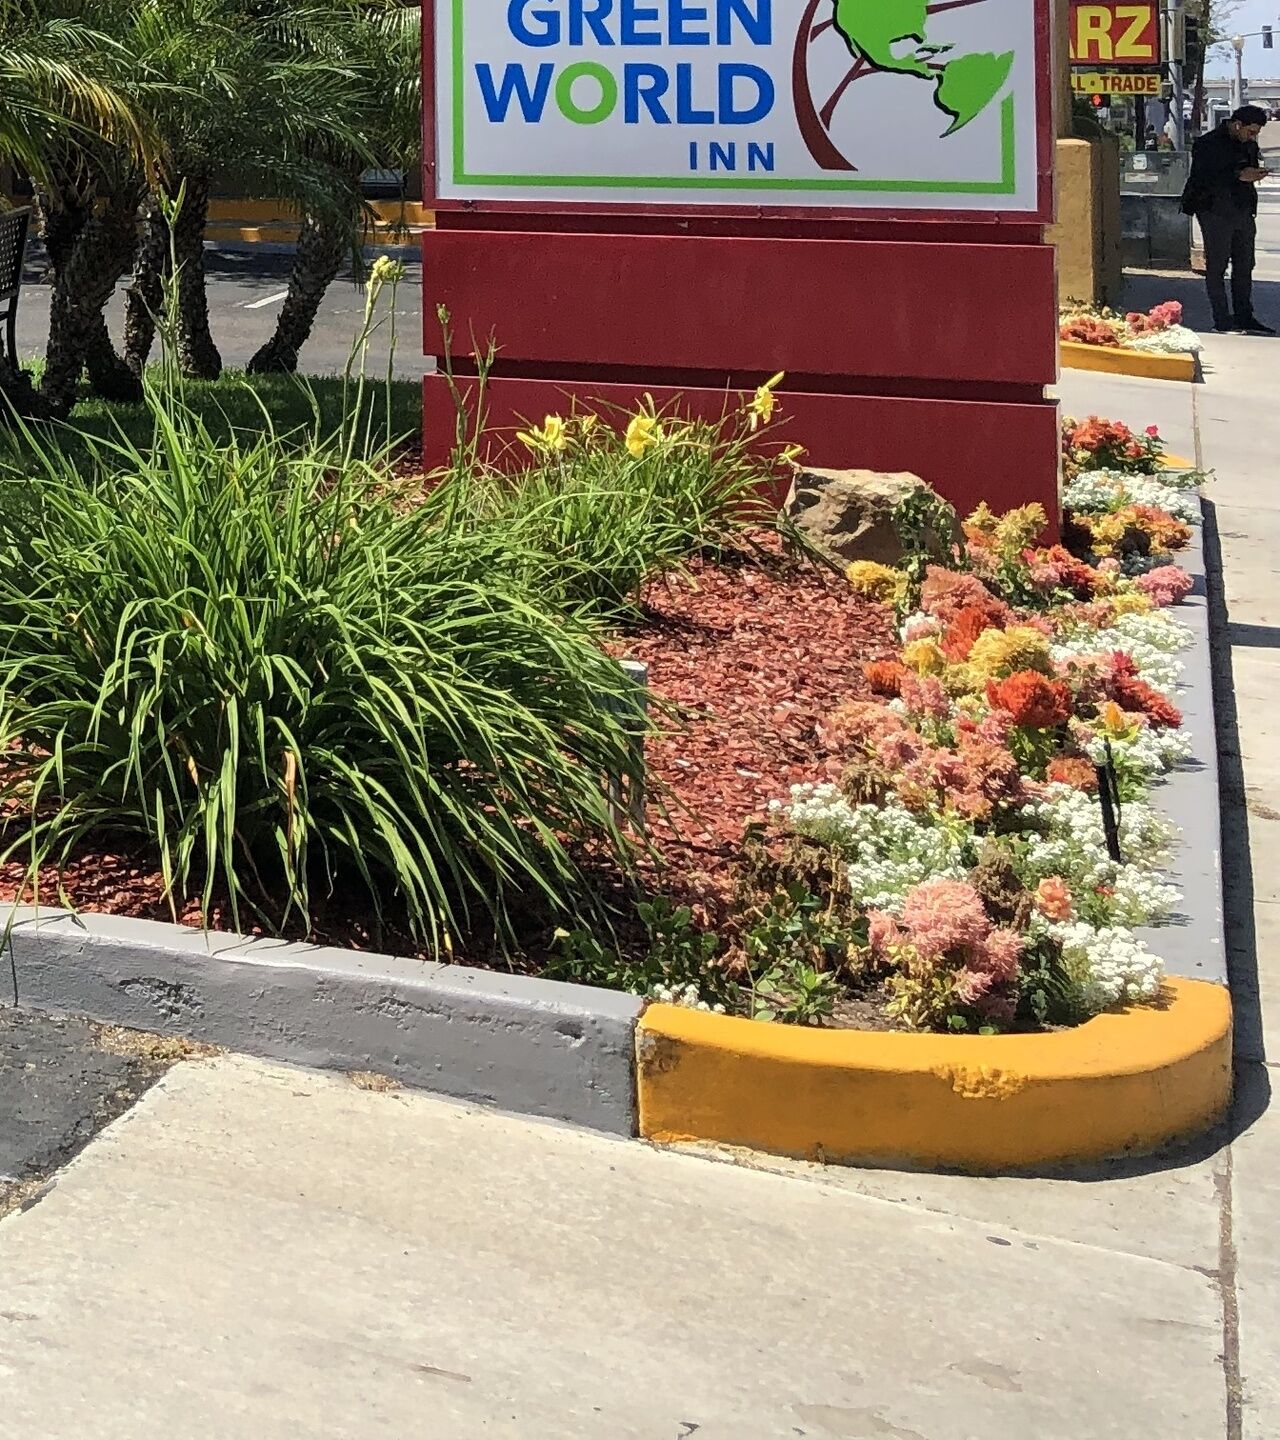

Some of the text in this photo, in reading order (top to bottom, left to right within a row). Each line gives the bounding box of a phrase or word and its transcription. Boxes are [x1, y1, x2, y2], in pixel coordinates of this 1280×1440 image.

[1069, 6, 1152, 60] RZ
[474, 61, 775, 124] WORLD
[1100, 76, 1158, 92] TRADE
[689, 141, 775, 172] INN
